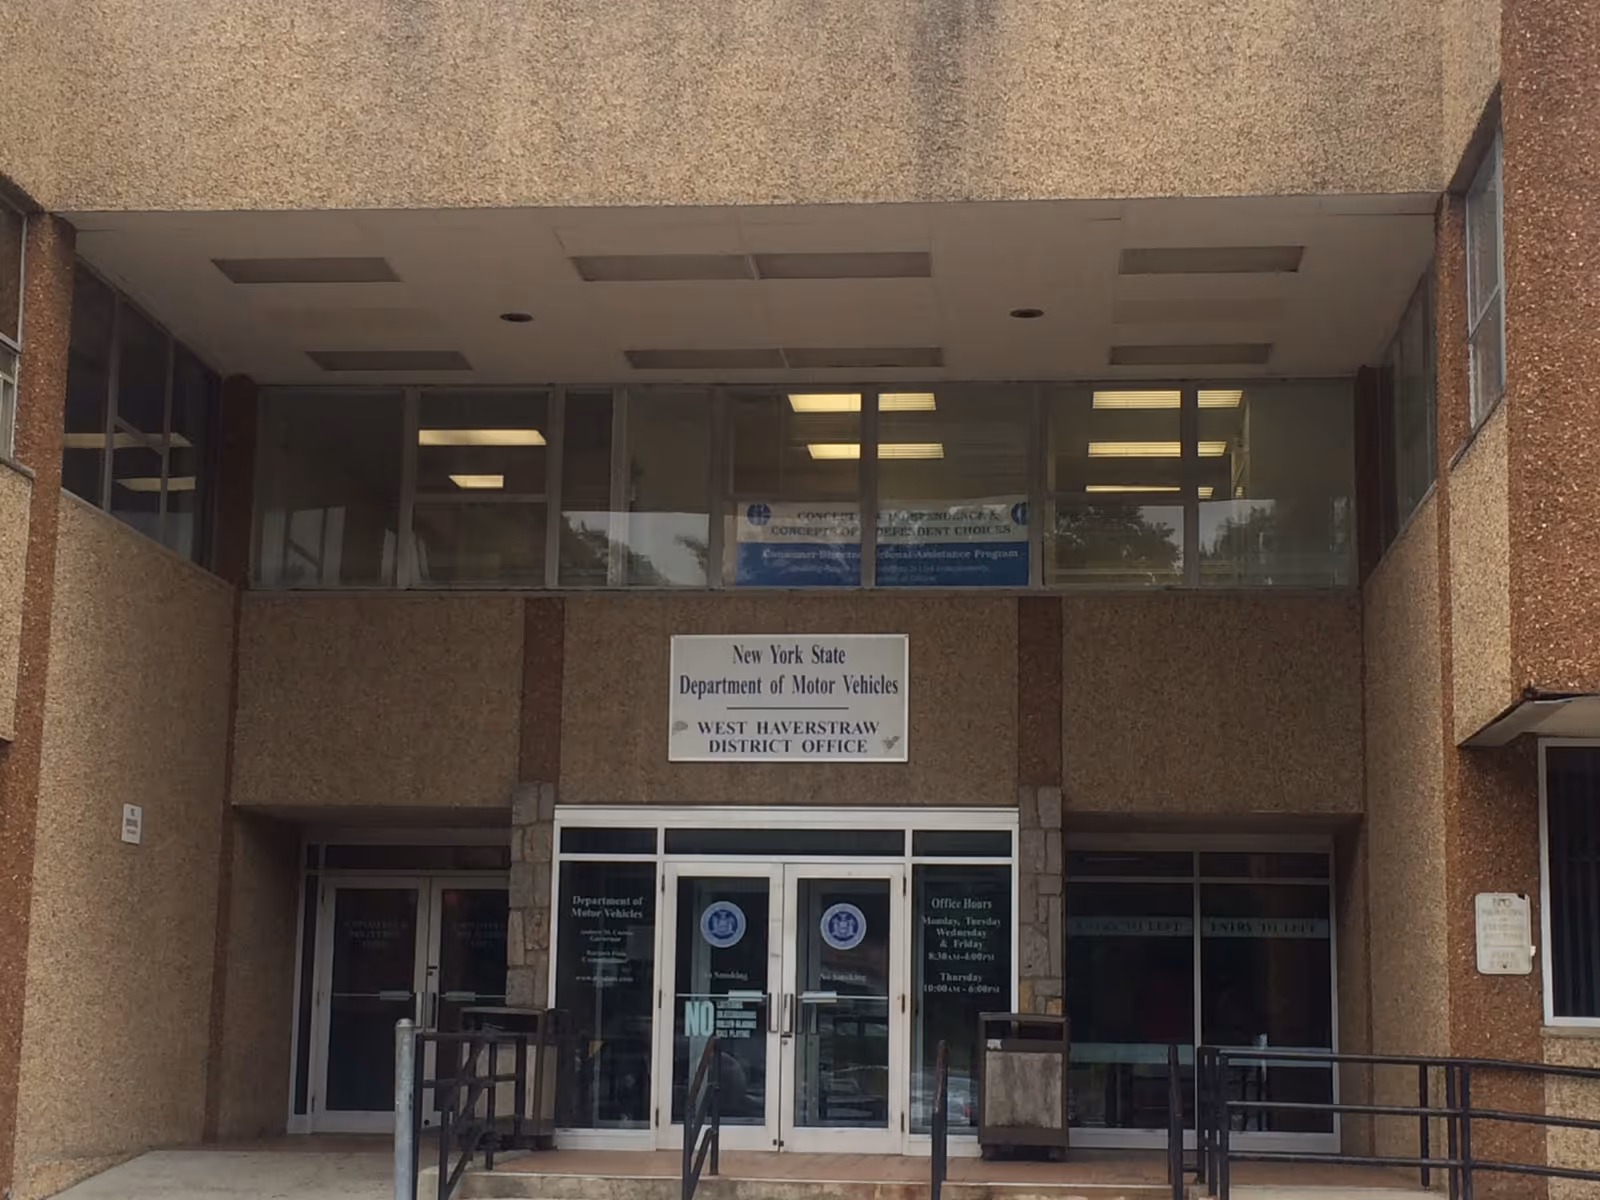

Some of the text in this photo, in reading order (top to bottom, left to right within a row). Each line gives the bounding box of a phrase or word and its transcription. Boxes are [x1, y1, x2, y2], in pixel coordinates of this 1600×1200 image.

[841, 526, 860, 536] OF
[954, 525, 1011, 536] CHOICES
[915, 550, 970, 559] Assistance
[974, 549, 1019, 560] Program
[733, 644, 846, 664] New York State
[679, 674, 899, 700] Department of Motor Vehicles
[698, 721, 880, 735] WEST HAVERSTRAW
[709, 739, 868, 753] DISTRICT OFFICE
[572, 895, 644, 907] Department of
[931, 898, 992, 909] Office Hours
[572, 907, 643, 919] Motor Vehicles
[965, 916, 1001, 928] Tuesday
[936, 928, 986, 938] Wednesday
[940, 939, 983, 950] & Friday
[939, 972, 982, 983] Thursday
[923, 984, 960, 993] 10:00AM
[968, 984, 1000, 993] 6:00PM
[684, 1000, 715, 1037] NO
